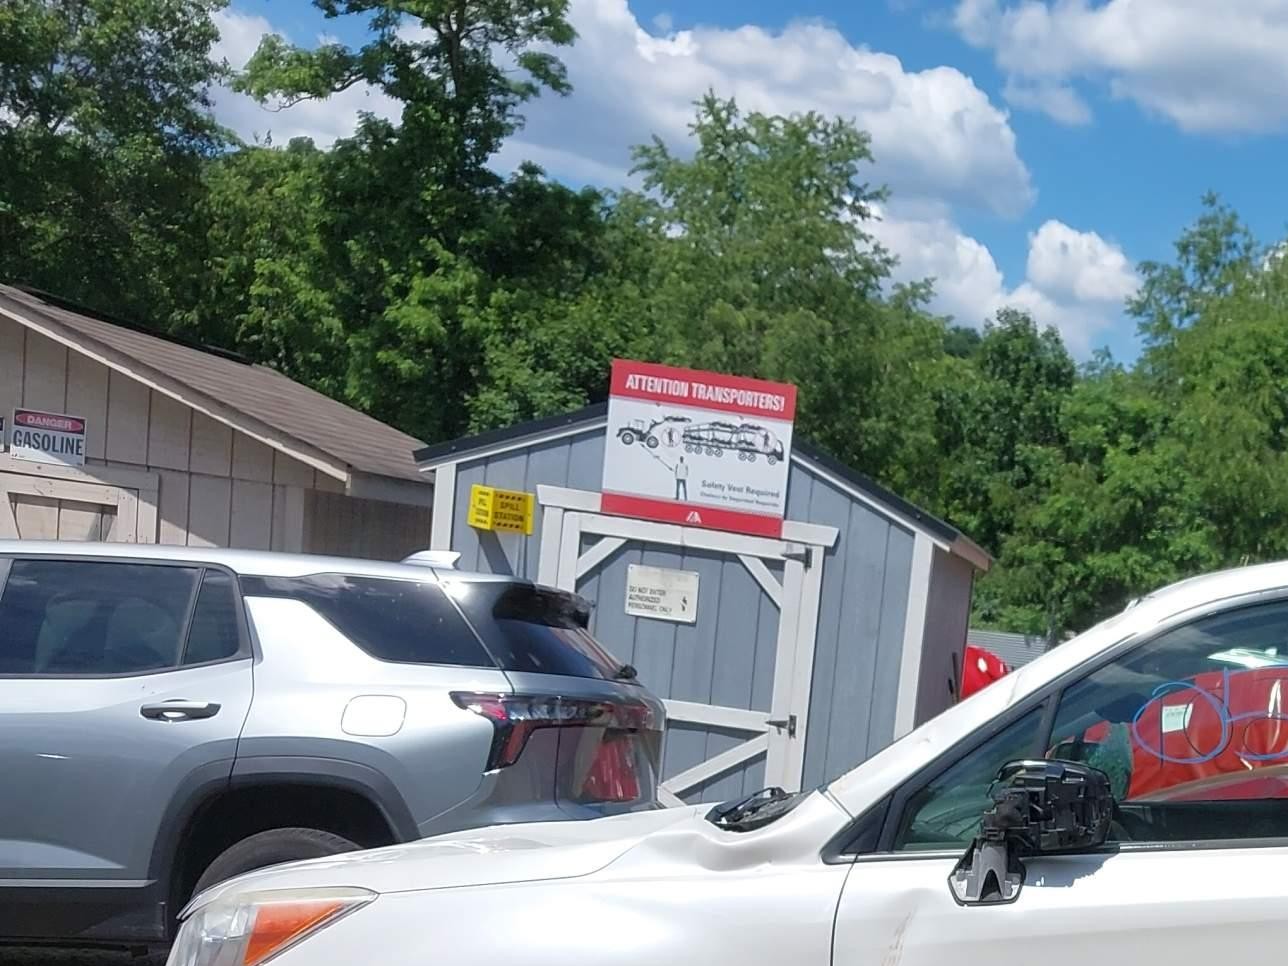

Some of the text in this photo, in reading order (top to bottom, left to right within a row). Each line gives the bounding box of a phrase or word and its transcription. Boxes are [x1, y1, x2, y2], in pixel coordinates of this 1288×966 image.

[625, 374, 785, 412] ATTENTION TRANSPORTERS!
[27, 415, 72, 431] DANGER
[13, 429, 85, 456] GASOLINE
[701, 480, 780, 498] Safety Vest Required
